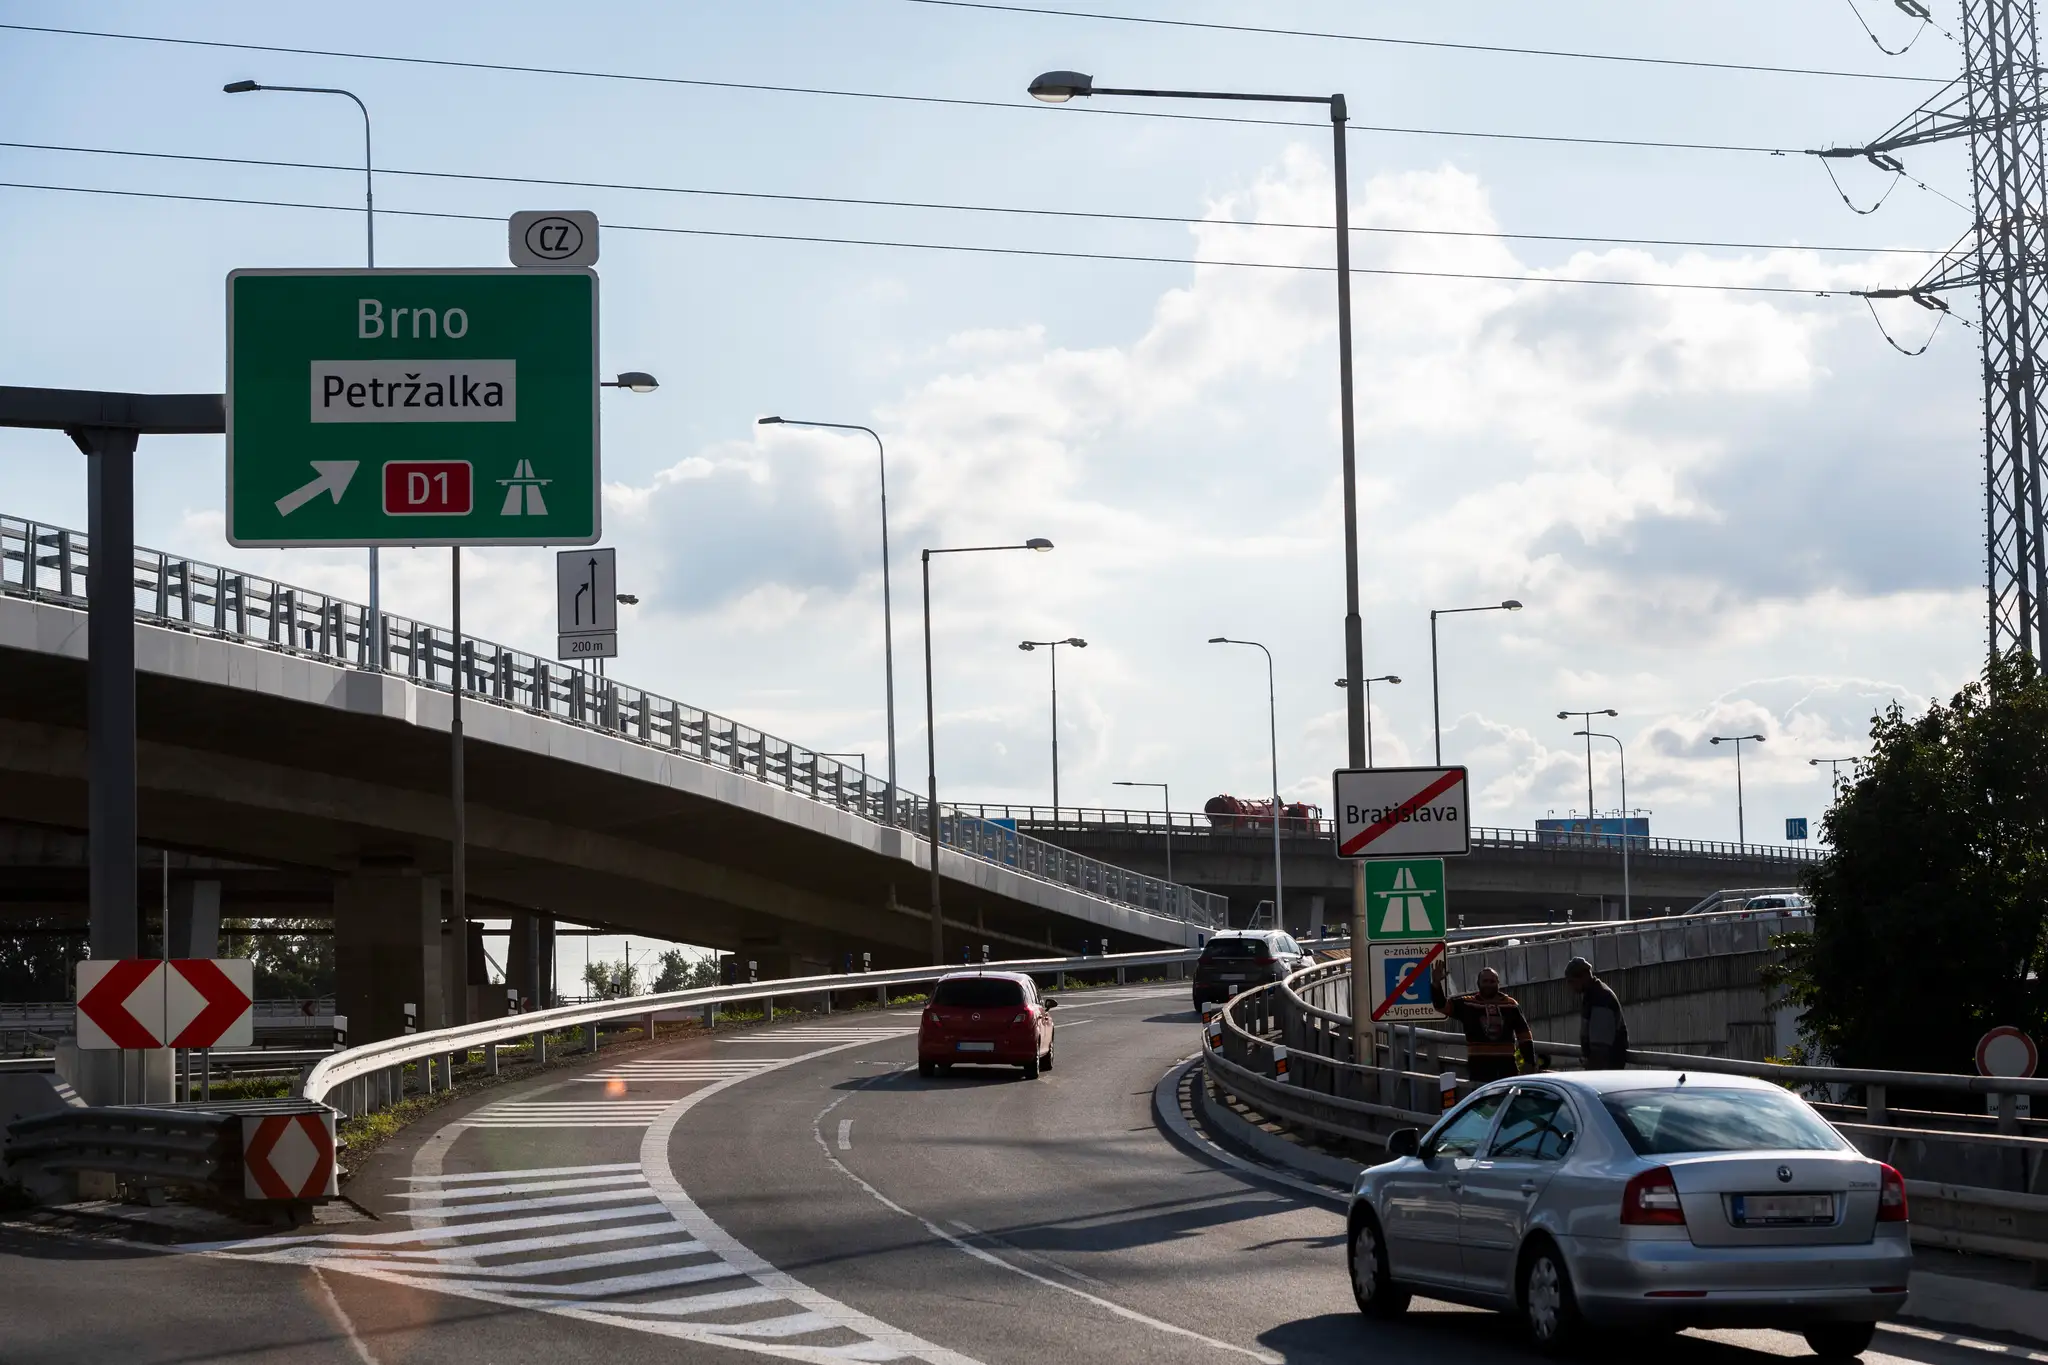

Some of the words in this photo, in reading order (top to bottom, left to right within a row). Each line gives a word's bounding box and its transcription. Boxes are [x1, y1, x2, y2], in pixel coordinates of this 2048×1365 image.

[538, 225, 570, 252] CZ
[357, 298, 469, 339] Brno
[323, 372, 505, 408] Petržalka
[407, 471, 449, 505] D1
[572, 641, 591, 652] 200
[593, 642, 603, 651] m
[1346, 802, 1458, 824] Bratislava
[1384, 946, 1430, 956] e-známka
[1384, 1006, 1434, 1017] e-Vignette
